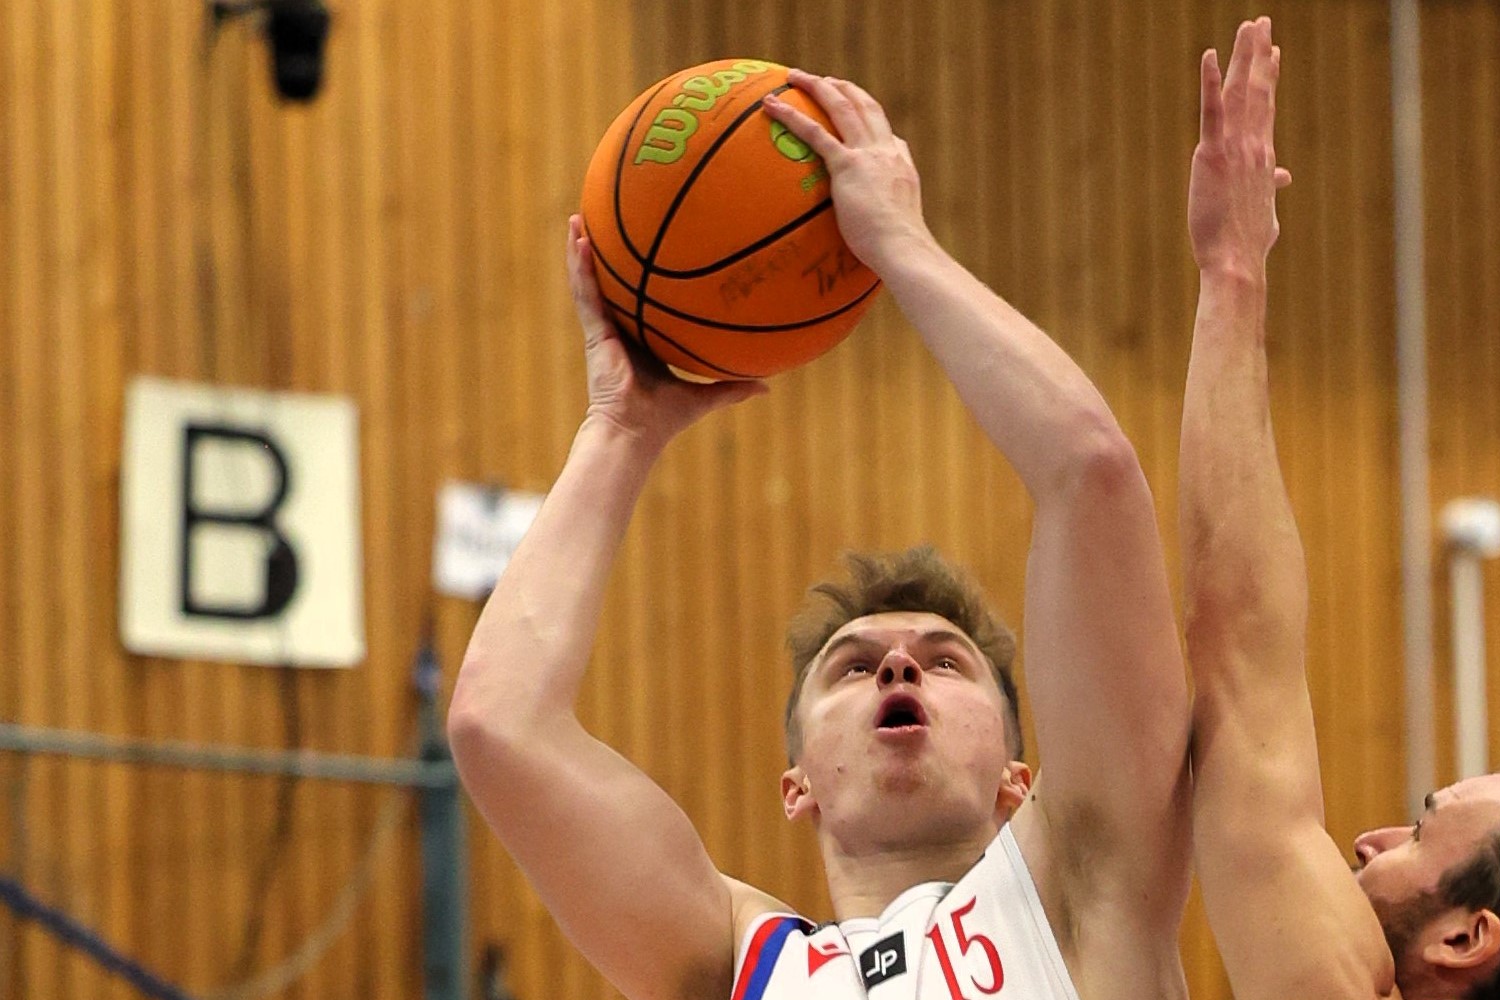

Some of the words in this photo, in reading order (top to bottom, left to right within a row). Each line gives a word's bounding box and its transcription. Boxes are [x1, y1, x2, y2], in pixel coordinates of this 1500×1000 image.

[633, 60, 782, 165] Wilso
[180, 424, 298, 619] B
[866, 949, 898, 978] JP
